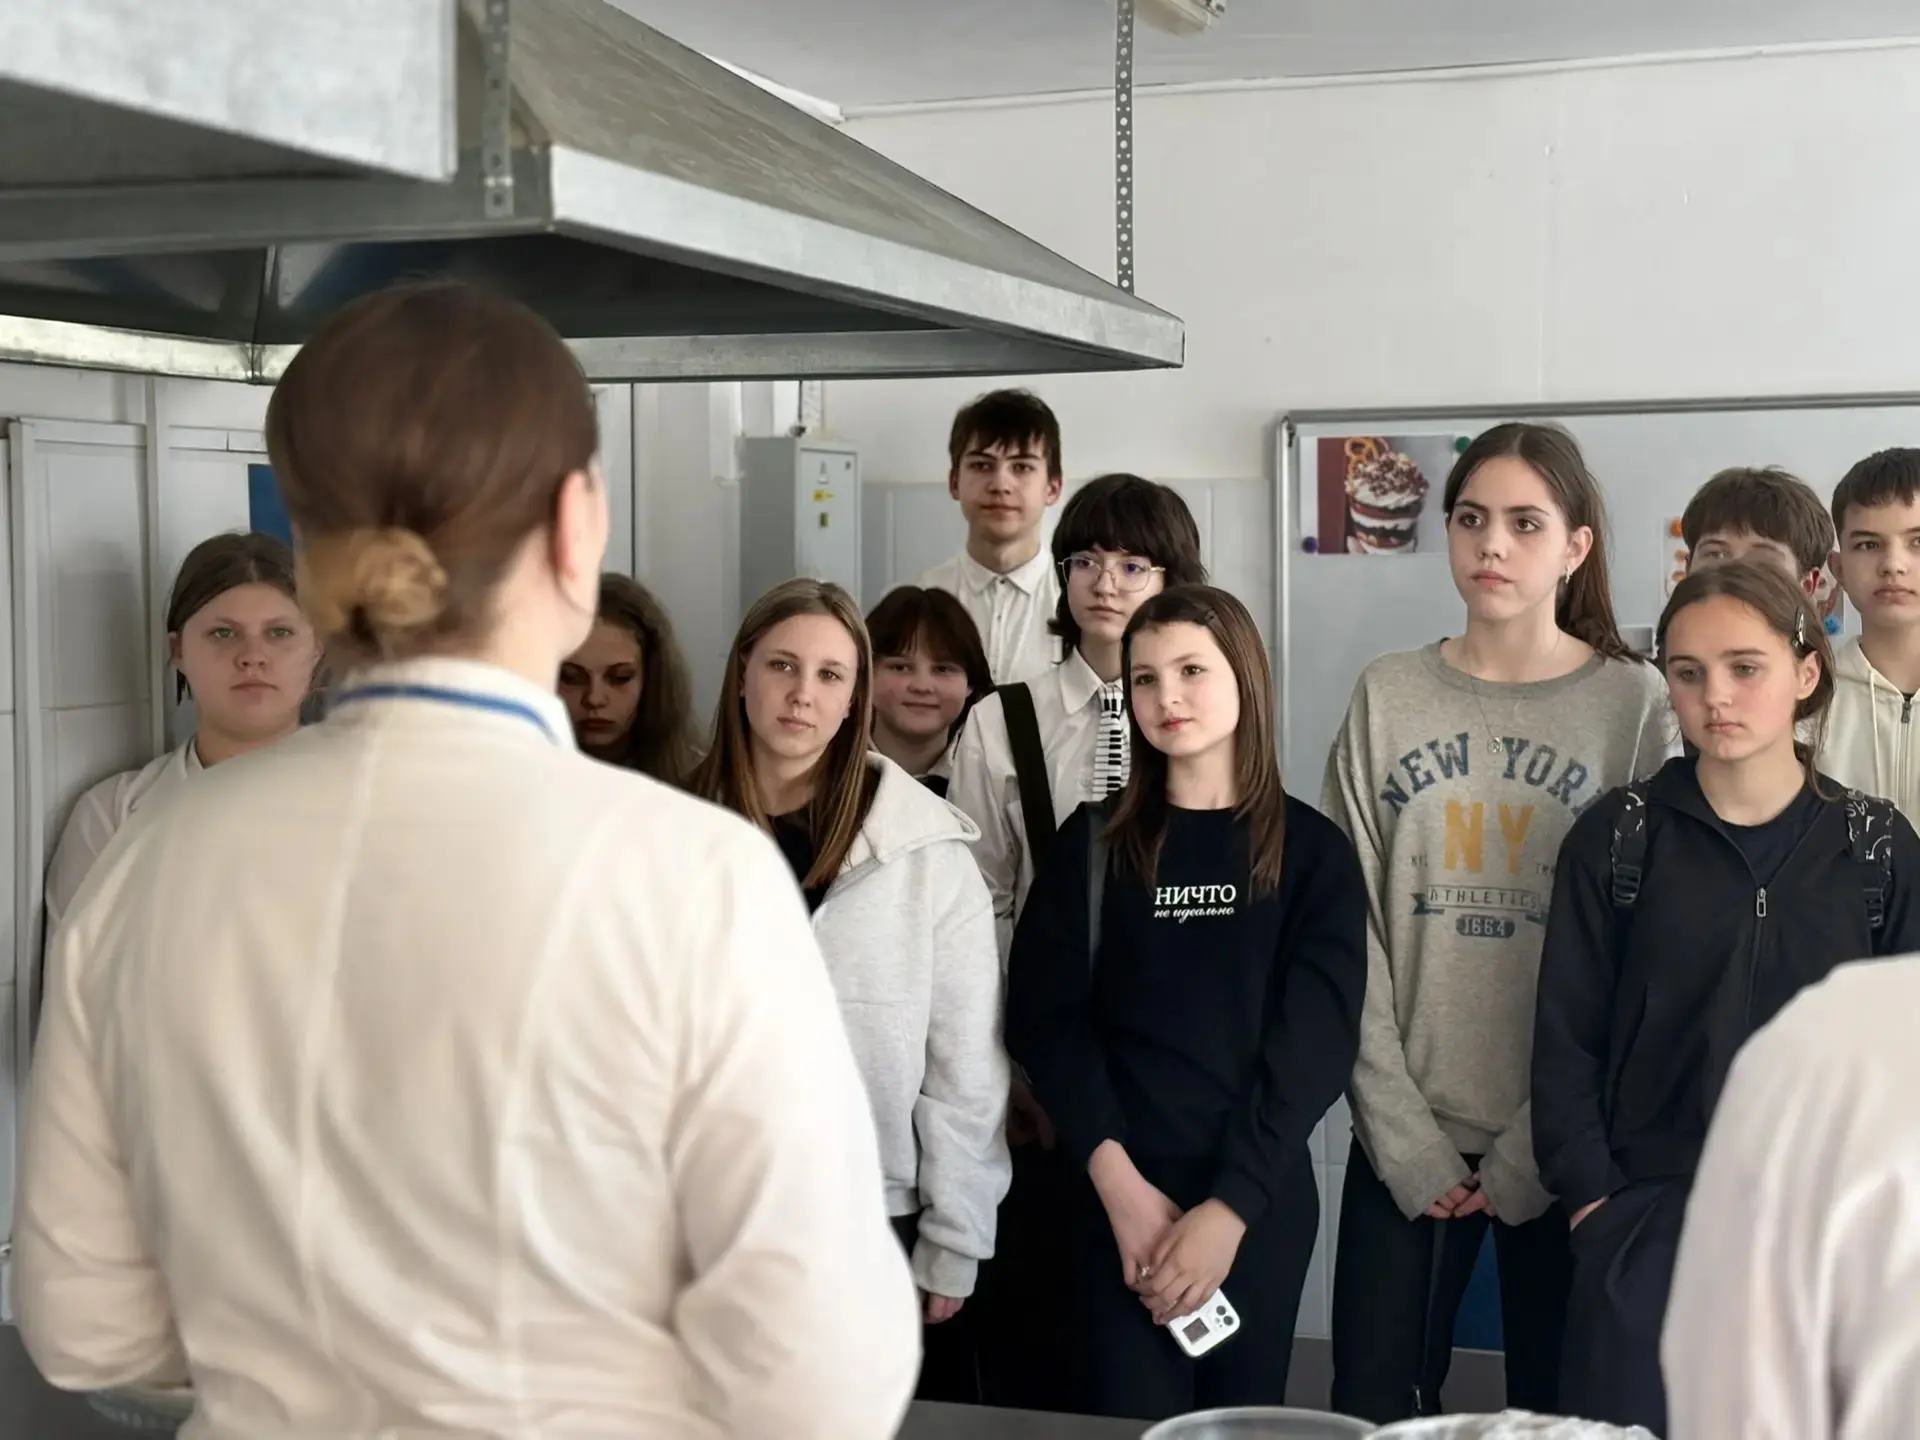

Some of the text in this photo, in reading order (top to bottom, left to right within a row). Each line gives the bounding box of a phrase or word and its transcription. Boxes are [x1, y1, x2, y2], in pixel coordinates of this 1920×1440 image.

[1379, 732, 1470, 818] NEW
[1443, 799, 1535, 876] NY
[1154, 884, 1237, 905] НИЧТО
[1429, 888, 1538, 909] ATHLETICS
[1154, 906, 1235, 924] не идеально
